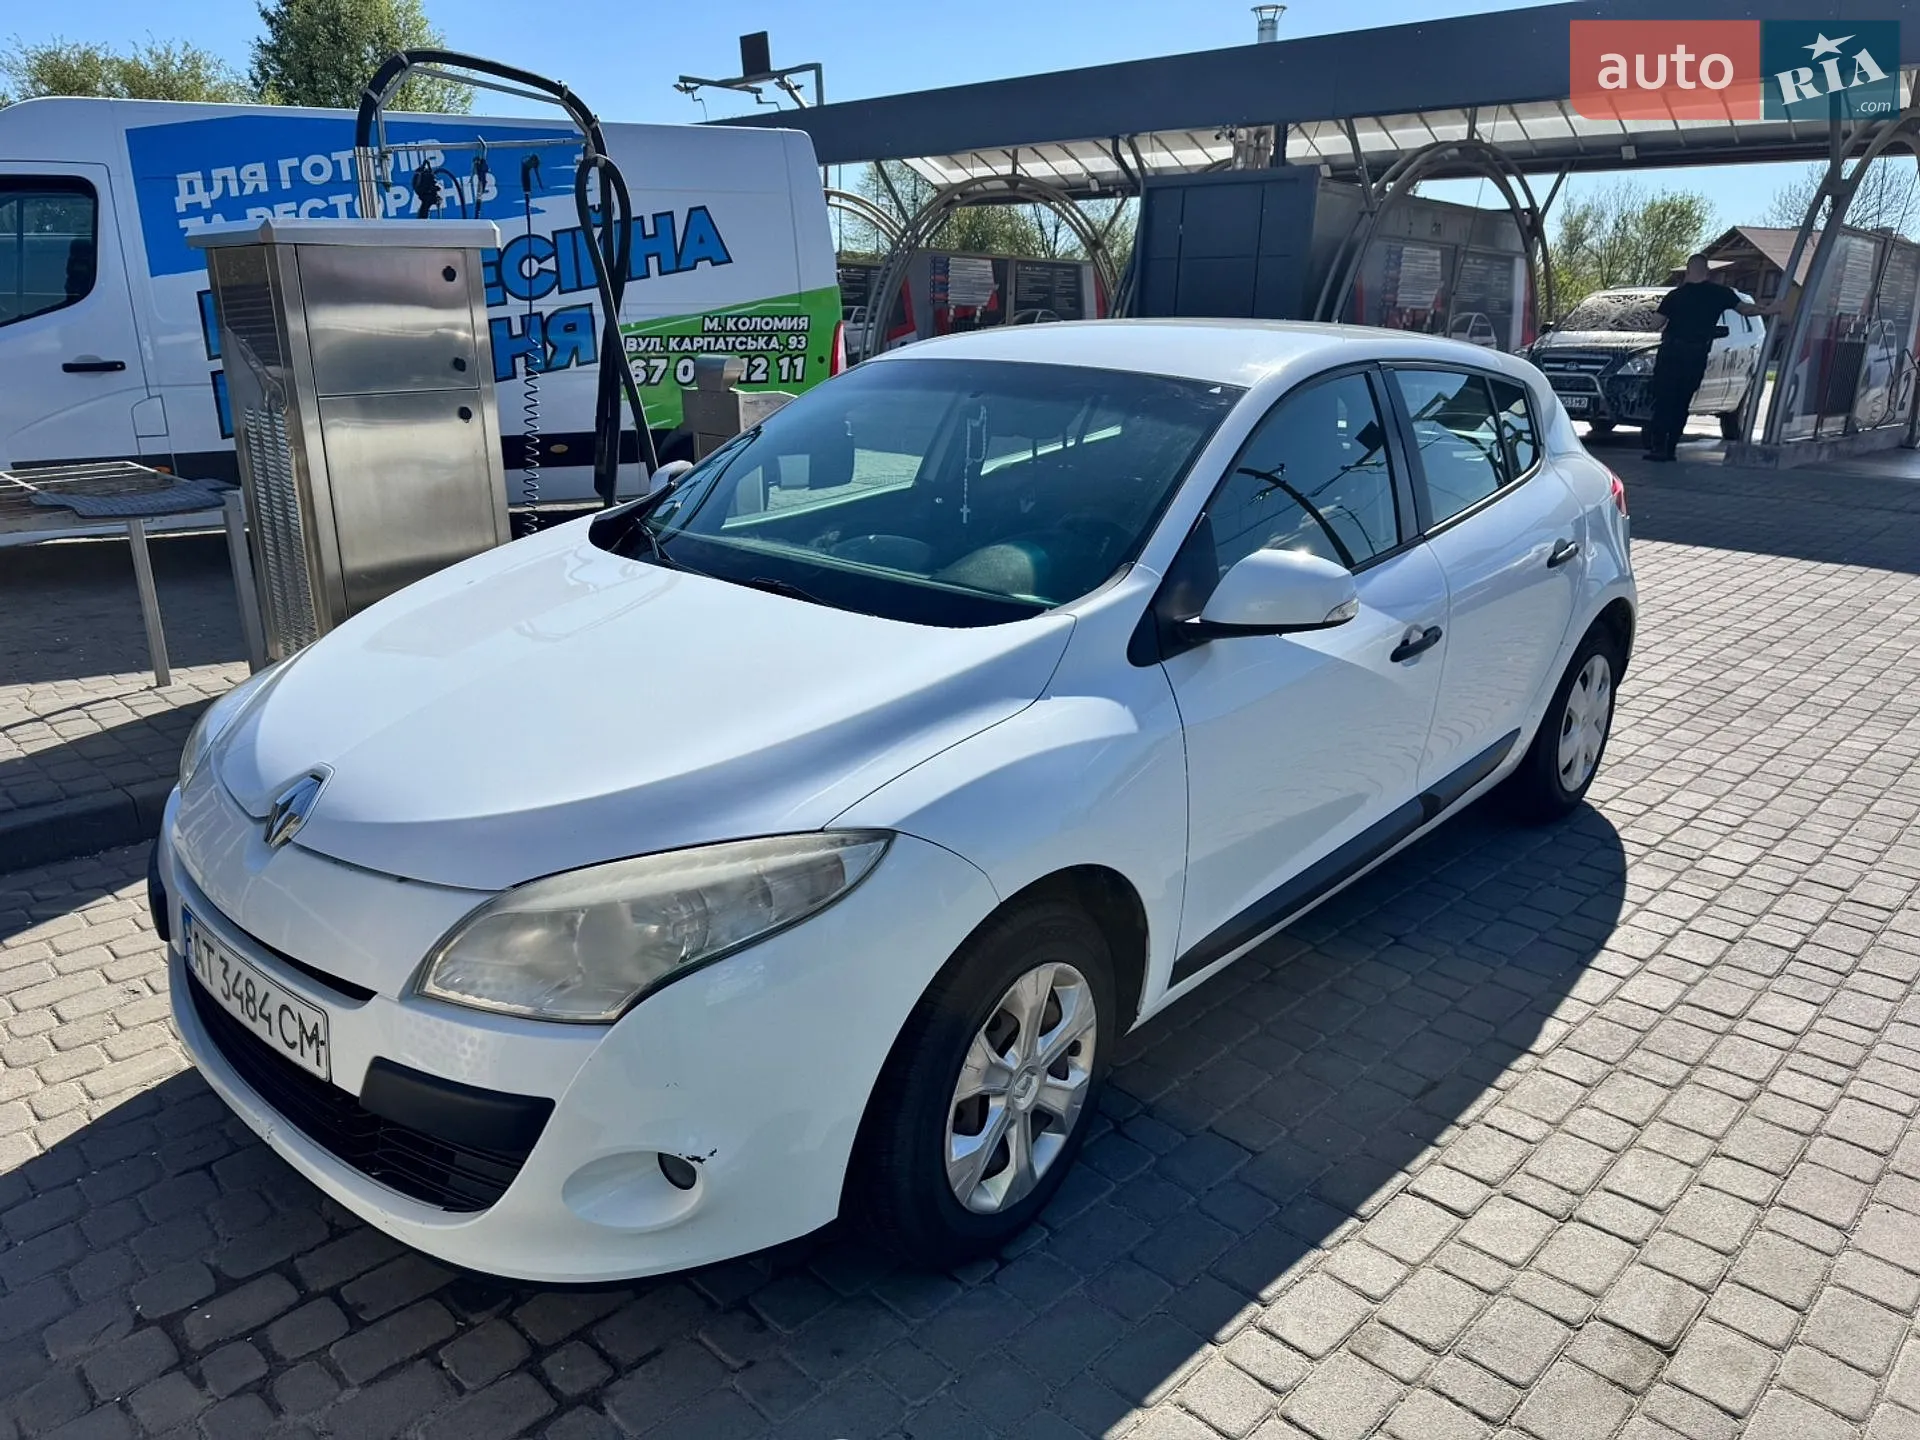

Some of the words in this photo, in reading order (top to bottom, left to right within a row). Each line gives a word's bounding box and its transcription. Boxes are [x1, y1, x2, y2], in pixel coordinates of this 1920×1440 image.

[174, 162, 269, 213] ДЛЯ
[277, 138, 445, 190] ГОТЛІВ
[703, 317, 721, 332] М.
[726, 316, 809, 332] КОЛОМИЯ
[626, 337, 664, 351] ВУЛ.
[669, 336, 783, 353] КАРПАТСЬКА,
[787, 335, 807, 349] 93
[778, 357, 804, 381] 11
[219, 957, 274, 1037] 3484
[278, 1003, 321, 1067] CM
